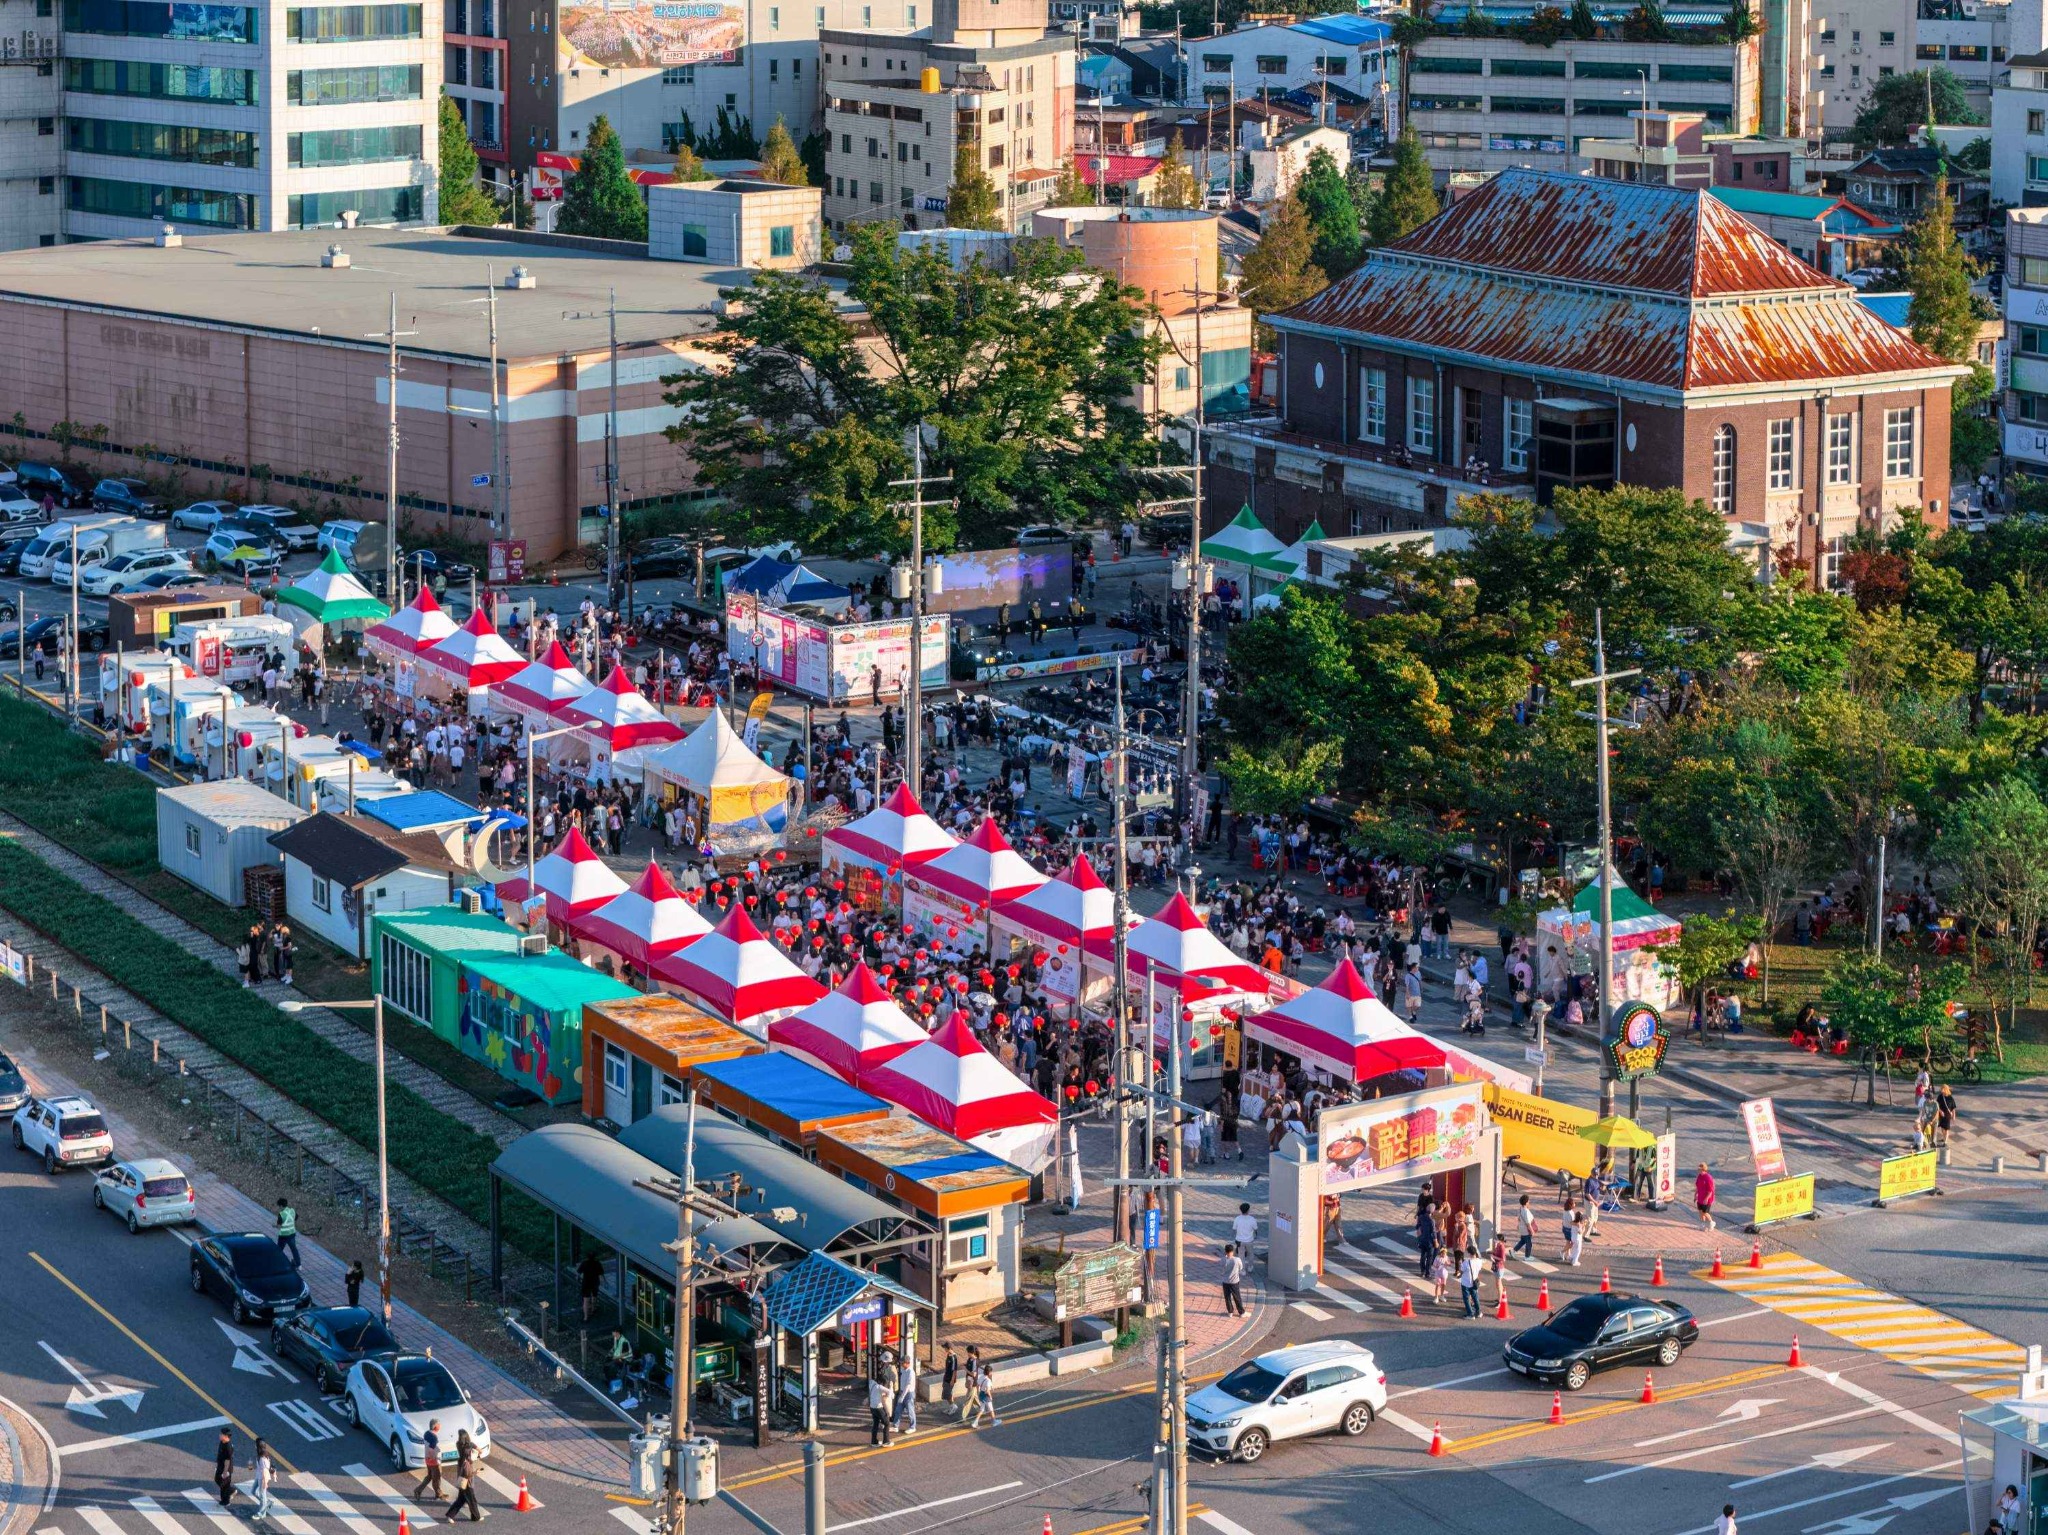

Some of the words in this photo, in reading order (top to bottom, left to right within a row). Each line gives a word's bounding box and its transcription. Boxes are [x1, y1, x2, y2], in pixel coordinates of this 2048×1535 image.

[653, 4, 722, 18] 확인하세요!
[541, 188, 555, 197] SK
[1625, 1046, 1658, 1062] FOOD
[1628, 1056, 1655, 1072] ZONE
[1486, 1099, 1524, 1122] NSAN
[1525, 1113, 1554, 1131] BEER
[1379, 1132, 1439, 1170] 페스티벌
